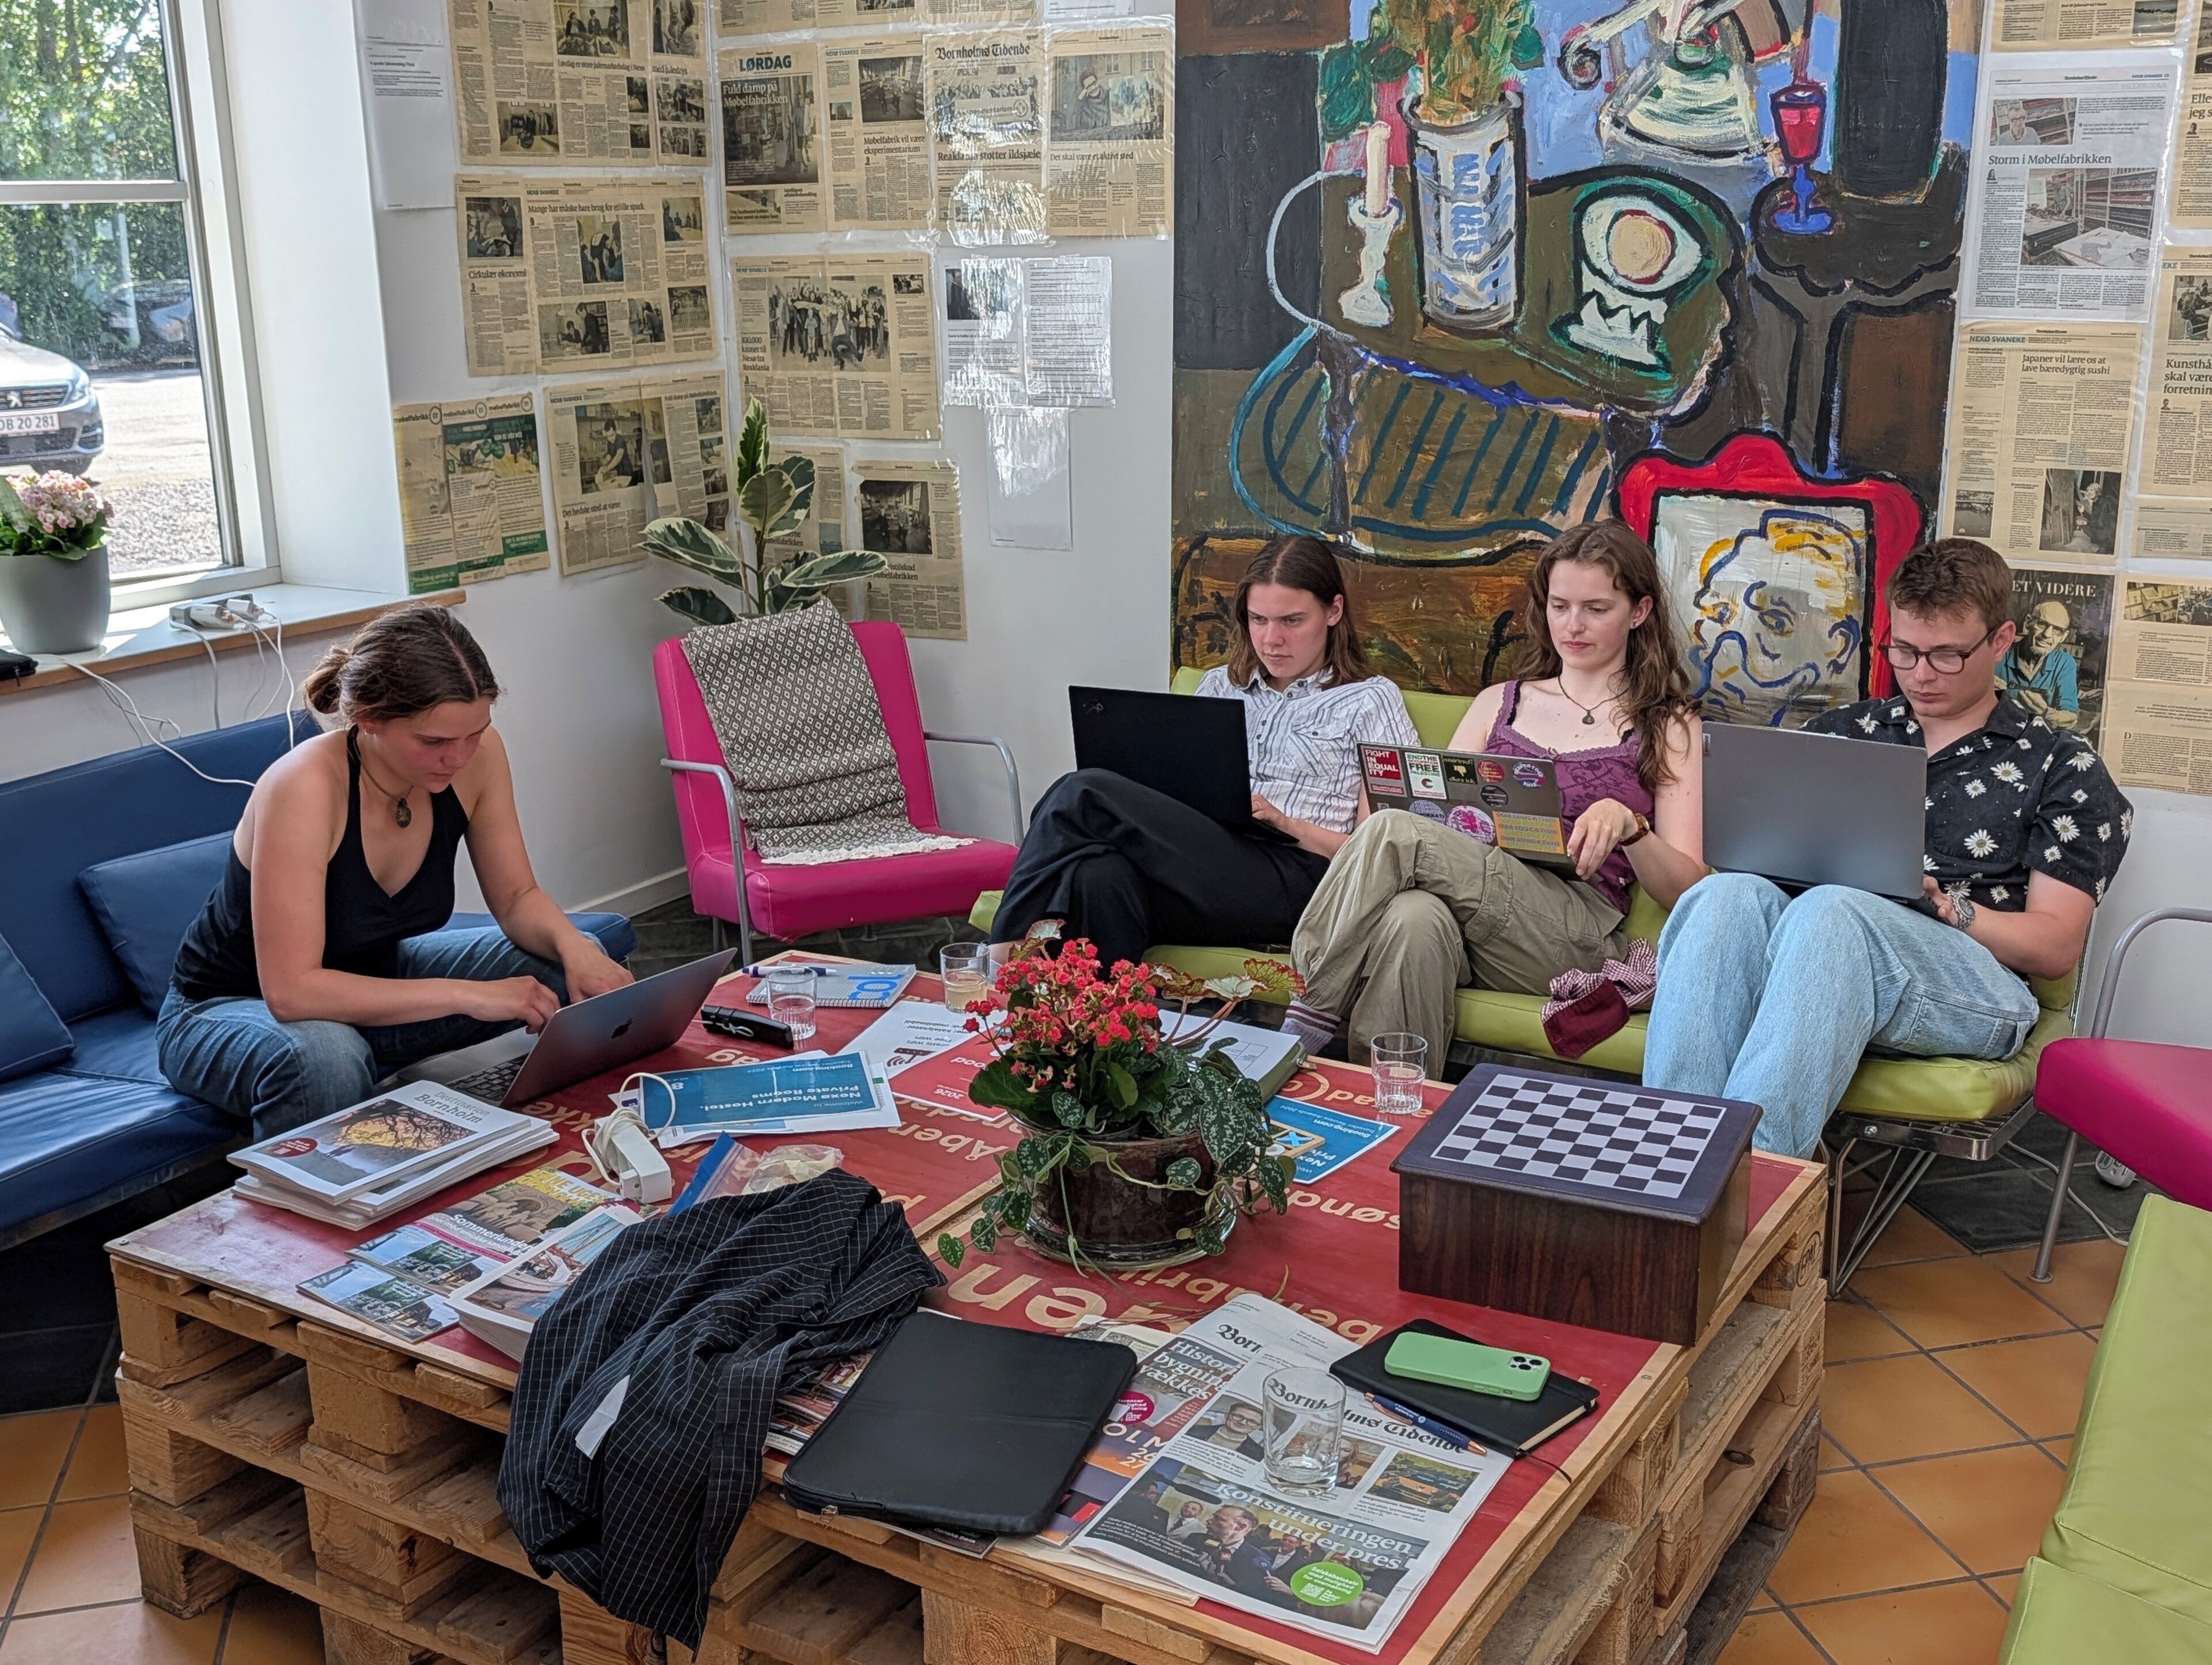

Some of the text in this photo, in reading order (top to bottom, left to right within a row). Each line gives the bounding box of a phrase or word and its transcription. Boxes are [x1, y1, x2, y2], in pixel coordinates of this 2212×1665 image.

[935, 43, 1031, 60] Bornholms Tidende
[739, 55, 791, 71] LØRDAG
[724, 81, 778, 95] Fuld damp på
[724, 94, 788, 108] Møbelfabrikken
[2188, 107, 2205, 119] jeg
[864, 136, 900, 145] Møbelfabrik
[910, 135, 925, 143] være
[864, 146, 921, 155] eksperimentarium
[979, 151, 1007, 160] støtter
[1008, 150, 1041, 161] ildsjæle
[1050, 153, 1059, 161] Det
[1060, 152, 1074, 161] skal
[1119, 151, 1134, 160] sted
[1988, 154, 2112, 165] Storm i Møbelfabrikken
[528, 204, 547, 213] Mange
[630, 203, 645, 213] spark
[468, 268, 527, 279] Cirkulær økonomi
[1969, 335, 2025, 343] NEXØ SVANEKE
[2022, 355, 2053, 365] Japaner
[2055, 355, 2065, 363] vil
[2067, 355, 2086, 364] lære
[2166, 358, 2212, 369] Kunsthå
[2022, 364, 2109, 375] lave bæredygtig sushi
[2164, 371, 2187, 381] skal
[2163, 384, 2212, 395] forretnin
[17, 418, 32, 429] 20
[37, 416, 55, 428] 281
[562, 509, 572, 517] Det
[590, 504, 601, 513] sted
[2012, 579, 2097, 598] ET VIDERE
[1365, 749, 1391, 758] FIGHT
[1368, 763, 1399, 772] EQUAL
[1410, 763, 1440, 772] FREE
[906, 1025, 952, 1033] katalysator
[793, 1063, 854, 1073] Booking.com
[950, 1056, 988, 1071] ood
[752, 1084, 859, 1099] Private Rooms
[934, 1088, 964, 1099] 2026
[434, 1092, 490, 1116] Destination
[699, 1091, 861, 1112] Nexø Modern Hostel.
[825, 1099, 865, 1108] Welcome
[414, 1093, 483, 1124] Bornholm
[1314, 1118, 1372, 1139] Booking.com
[888, 1124, 1009, 1161] Åben
[1297, 1155, 1326, 1167] Nex
[1309, 1149, 1337, 1160] Priv
[1169, 1341, 1245, 1376] Histori
[1141, 1362, 1211, 1400] vækkes
[1103, 1423, 1167, 1448] OLM
[1119, 1456, 1149, 1469] 27
[1215, 1481, 1413, 1555] Konstitueringen
[934, 1527, 977, 1543] Danske Bank
[1266, 1516, 1400, 1572] under pres
[1308, 1571, 1355, 1590] med mulighed
[1311, 1566, 1359, 1586] Selskabslokale
[1313, 1579, 1352, 1595] overnatning
